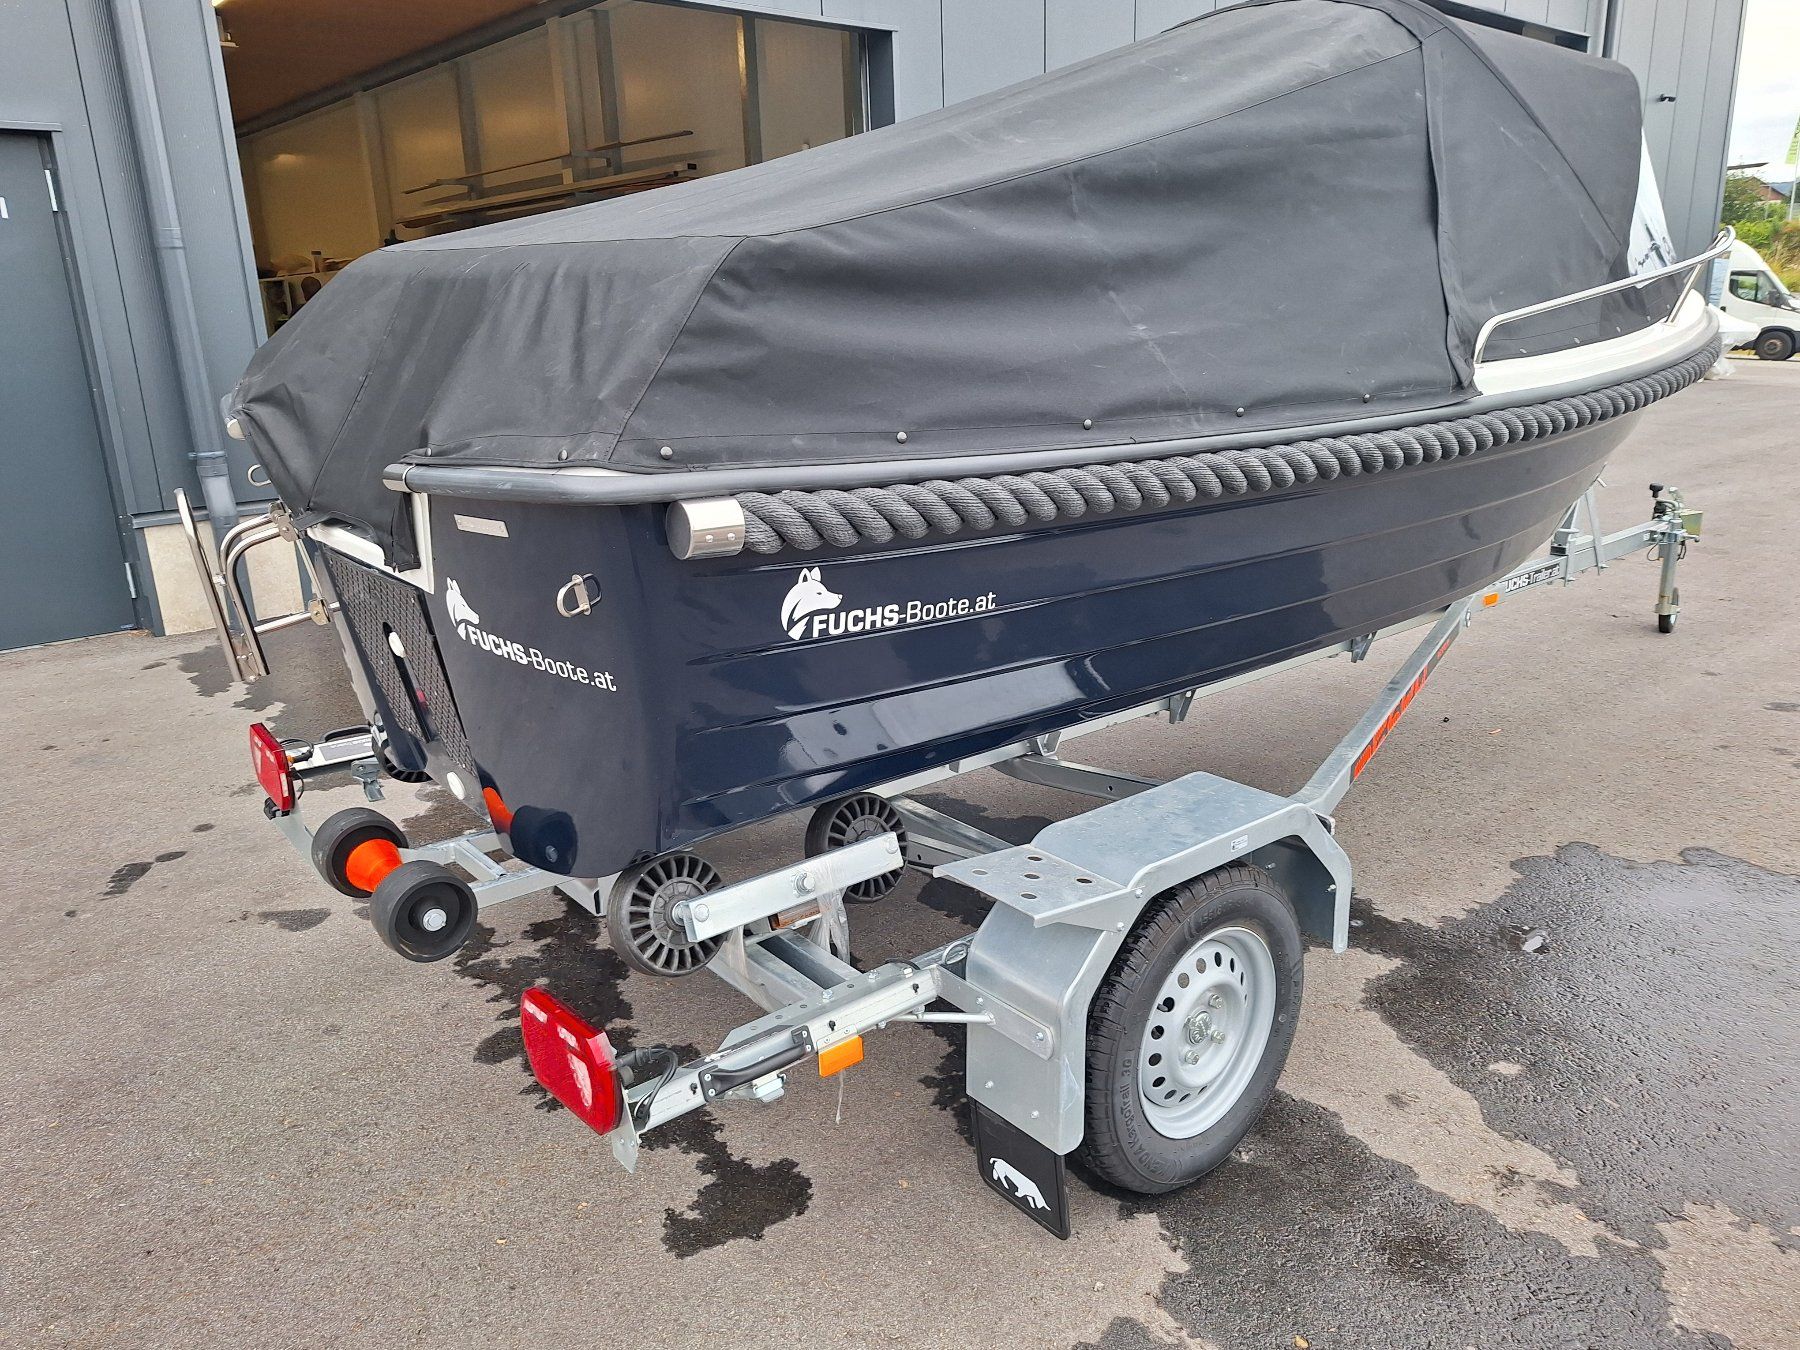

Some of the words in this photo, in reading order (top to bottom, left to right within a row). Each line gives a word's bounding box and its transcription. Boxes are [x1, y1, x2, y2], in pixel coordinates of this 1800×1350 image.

[1505, 565, 1560, 592] UCHS-Trailer.at
[812, 591, 997, 637] FUCHS-Boote.at
[467, 625, 617, 691] FUCHS-Boote.at
